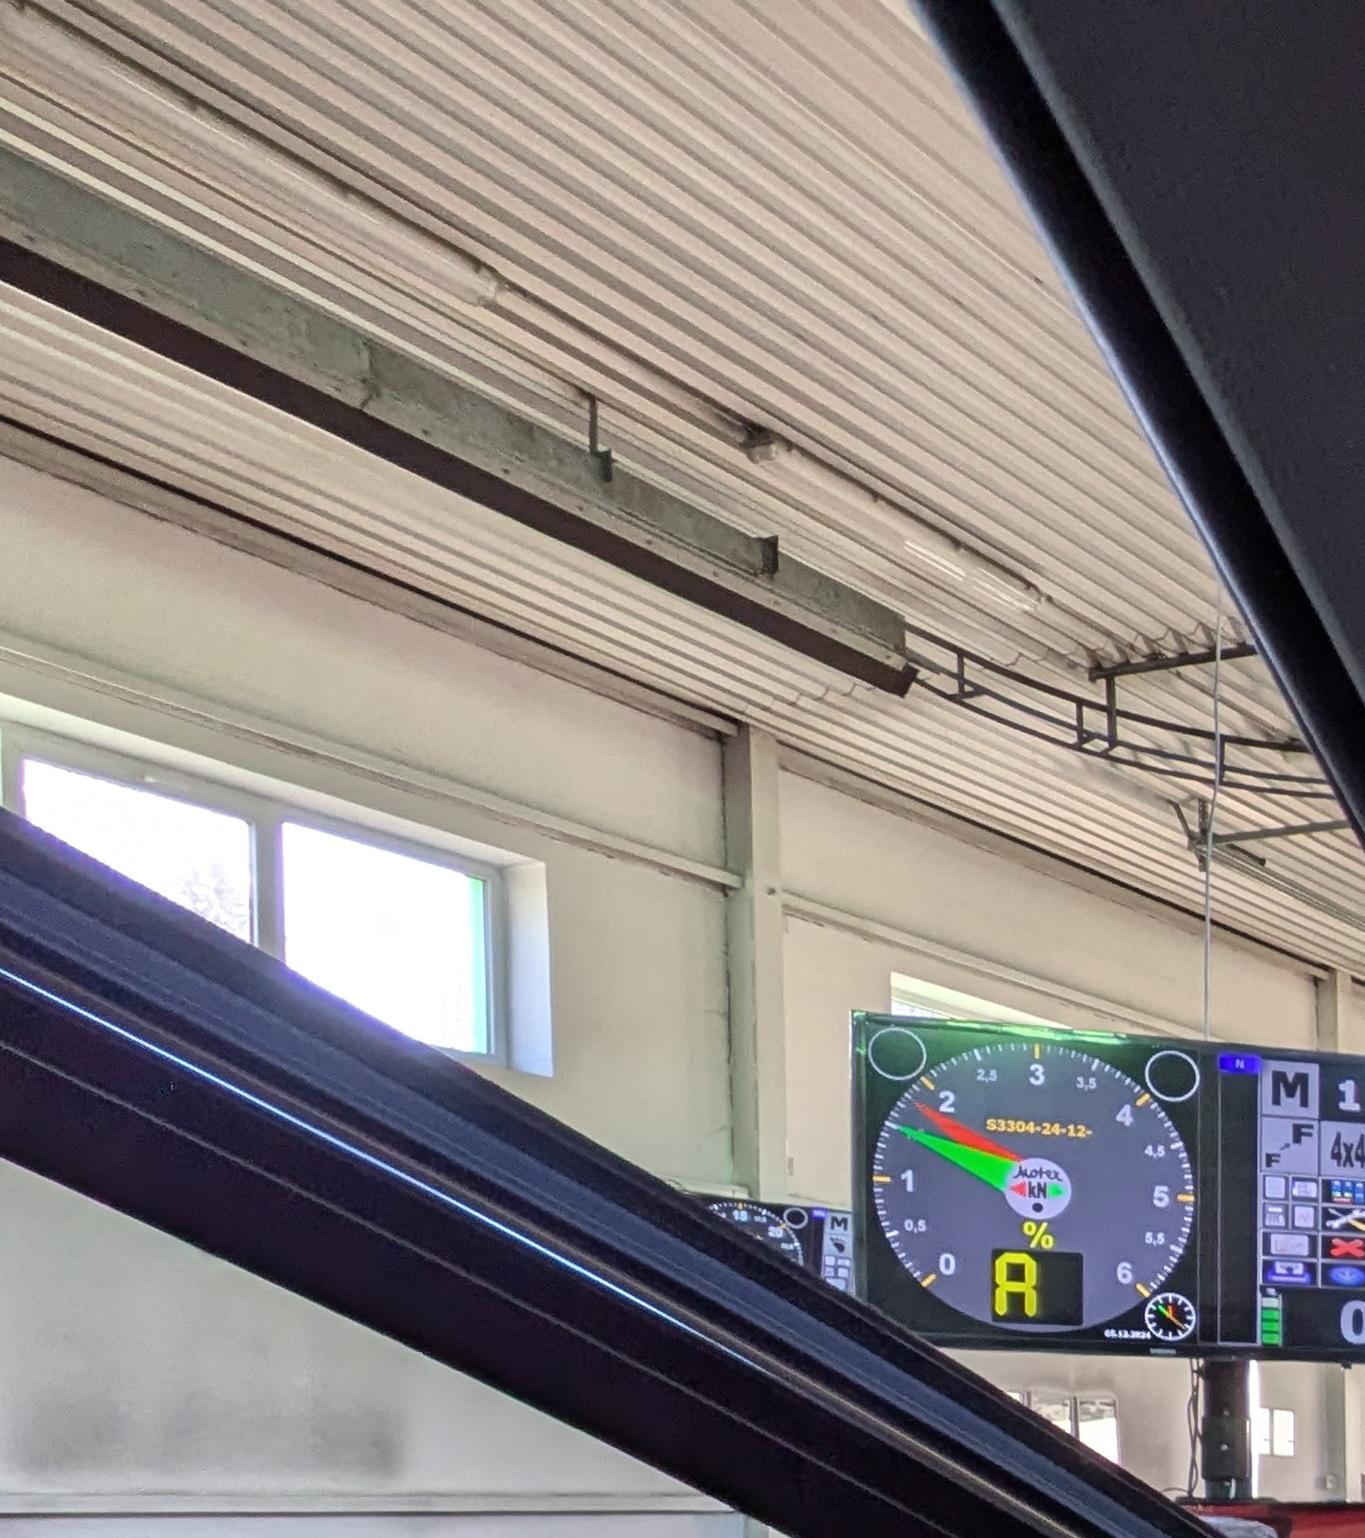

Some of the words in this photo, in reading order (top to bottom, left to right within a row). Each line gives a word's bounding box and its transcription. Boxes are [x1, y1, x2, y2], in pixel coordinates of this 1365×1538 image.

[976, 1069, 997, 1082] 2,5
[1029, 1064, 1045, 1085] 3
[1076, 1077, 1096, 1090] 3,5
[1272, 1070, 1309, 1108] M
[1338, 1080, 1361, 1112] 1
[939, 1091, 955, 1113] 2
[1116, 1105, 1133, 1127] 4
[1292, 1123, 1314, 1144] F
[1265, 1153, 1281, 1168] F
[901, 1170, 914, 1192] 1
[1028, 1184, 1047, 1199] kN
[1153, 1186, 1170, 1208] 5
[831, 1216, 848, 1231] M
[904, 1219, 926, 1233] 0,5
[1023, 1221, 1055, 1249] %
[1145, 1231, 1165, 1245] 5,5
[938, 1253, 956, 1275] 0
[1116, 1262, 1134, 1285] 6
[995, 1252, 1038, 1318] A
